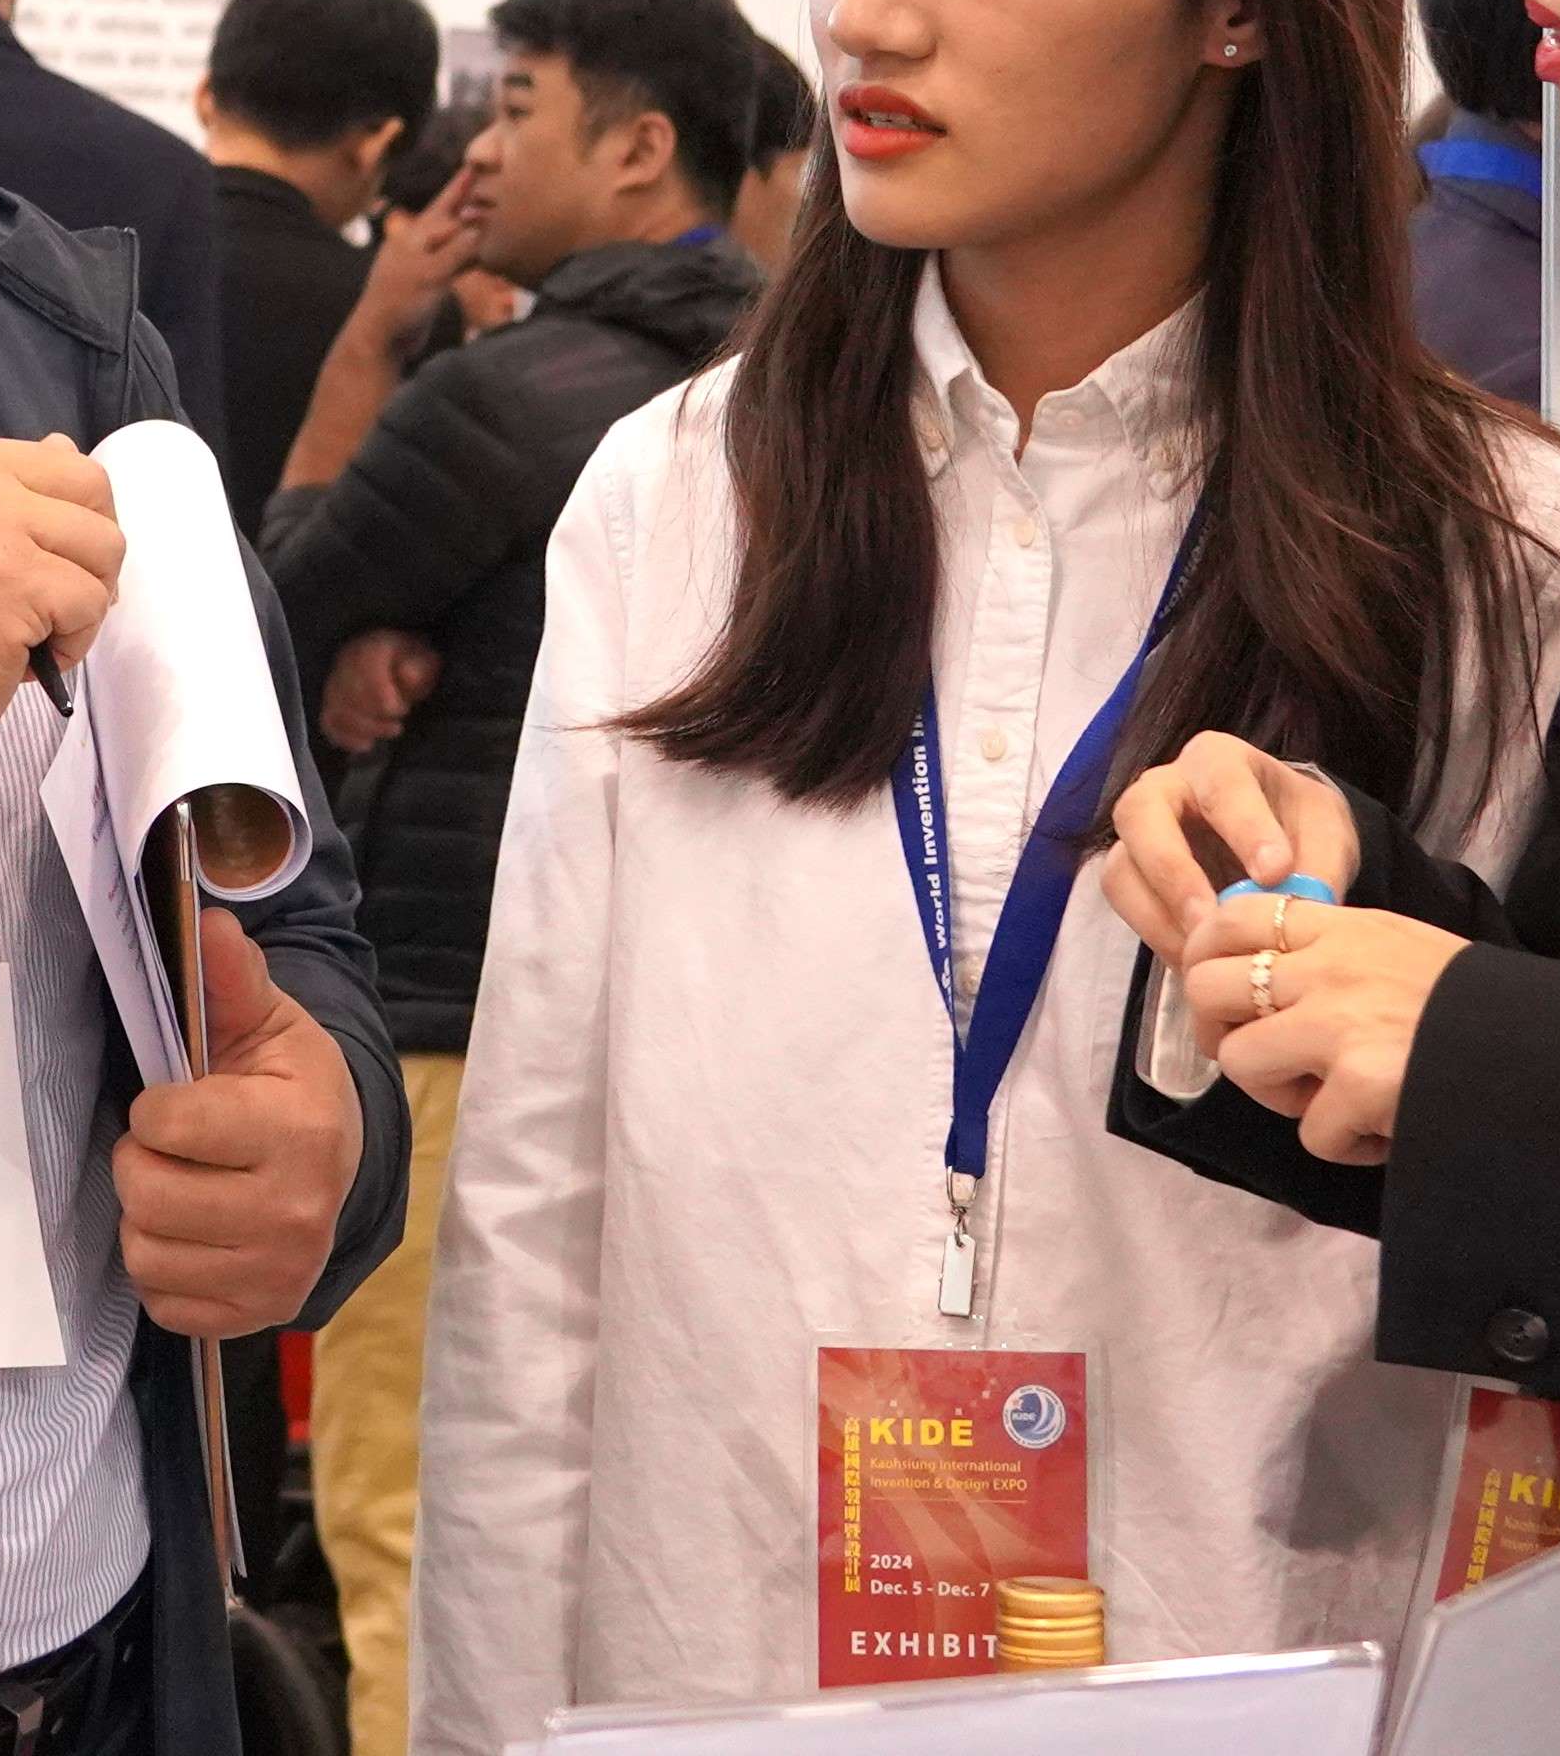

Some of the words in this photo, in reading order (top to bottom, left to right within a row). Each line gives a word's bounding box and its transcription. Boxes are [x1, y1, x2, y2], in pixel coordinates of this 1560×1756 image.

[911, 742, 938, 866] Invention
[926, 873, 947, 950] World
[869, 1417, 974, 1448] KIDE
[869, 1457, 937, 1473] Kaohsiung
[939, 1459, 1022, 1474] International
[869, 1476, 931, 1490] Invention
[933, 1478, 944, 1491] &
[945, 1477, 990, 1494] Design
[992, 1479, 1028, 1492] EXPO
[869, 1554, 913, 1570] 2024
[869, 1579, 908, 1595] Dec.
[912, 1581, 923, 1596] 5
[937, 1581, 976, 1597] Dec.
[979, 1582, 990, 1598] 7
[850, 1630, 1000, 1660] EXHIBIT
